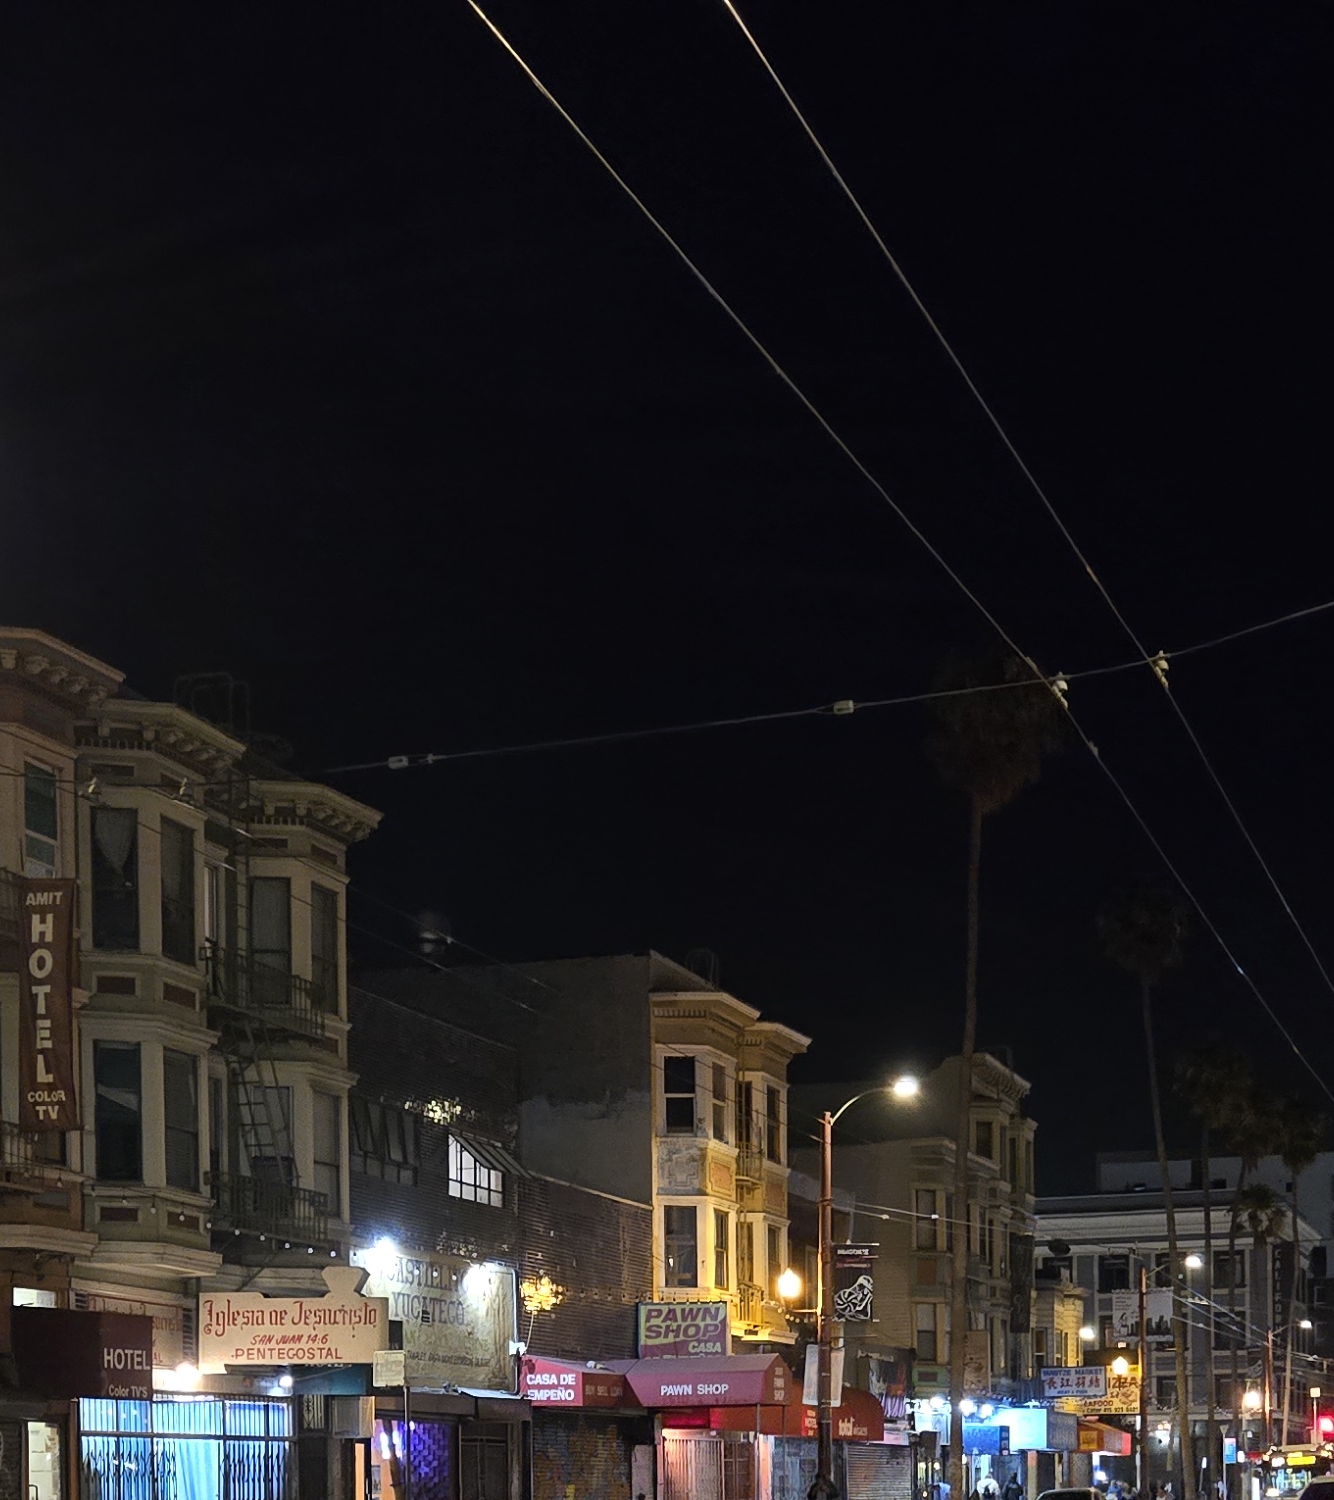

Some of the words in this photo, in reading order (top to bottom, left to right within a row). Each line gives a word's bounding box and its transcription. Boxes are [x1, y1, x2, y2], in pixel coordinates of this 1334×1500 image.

[26, 892, 63, 906] AMIT
[29, 913, 55, 1083] HOTEL
[28, 1089, 66, 1103] COLOR
[36, 1105, 59, 1120] TV
[644, 1306, 723, 1324] PAWN
[644, 1322, 722, 1340] SHOP
[250, 1334, 274, 1346] SAN
[275, 1333, 303, 1346] JUAN
[305, 1333, 329, 1345] 14:6
[688, 1341, 721, 1353] CASA
[103, 1348, 150, 1371] HOTEL
[526, 1374, 558, 1386] CASA
[559, 1373, 576, 1385] DE
[108, 1384, 129, 1397] Color
[660, 1384, 693, 1396] PAWN
[697, 1383, 729, 1395] SHOP
